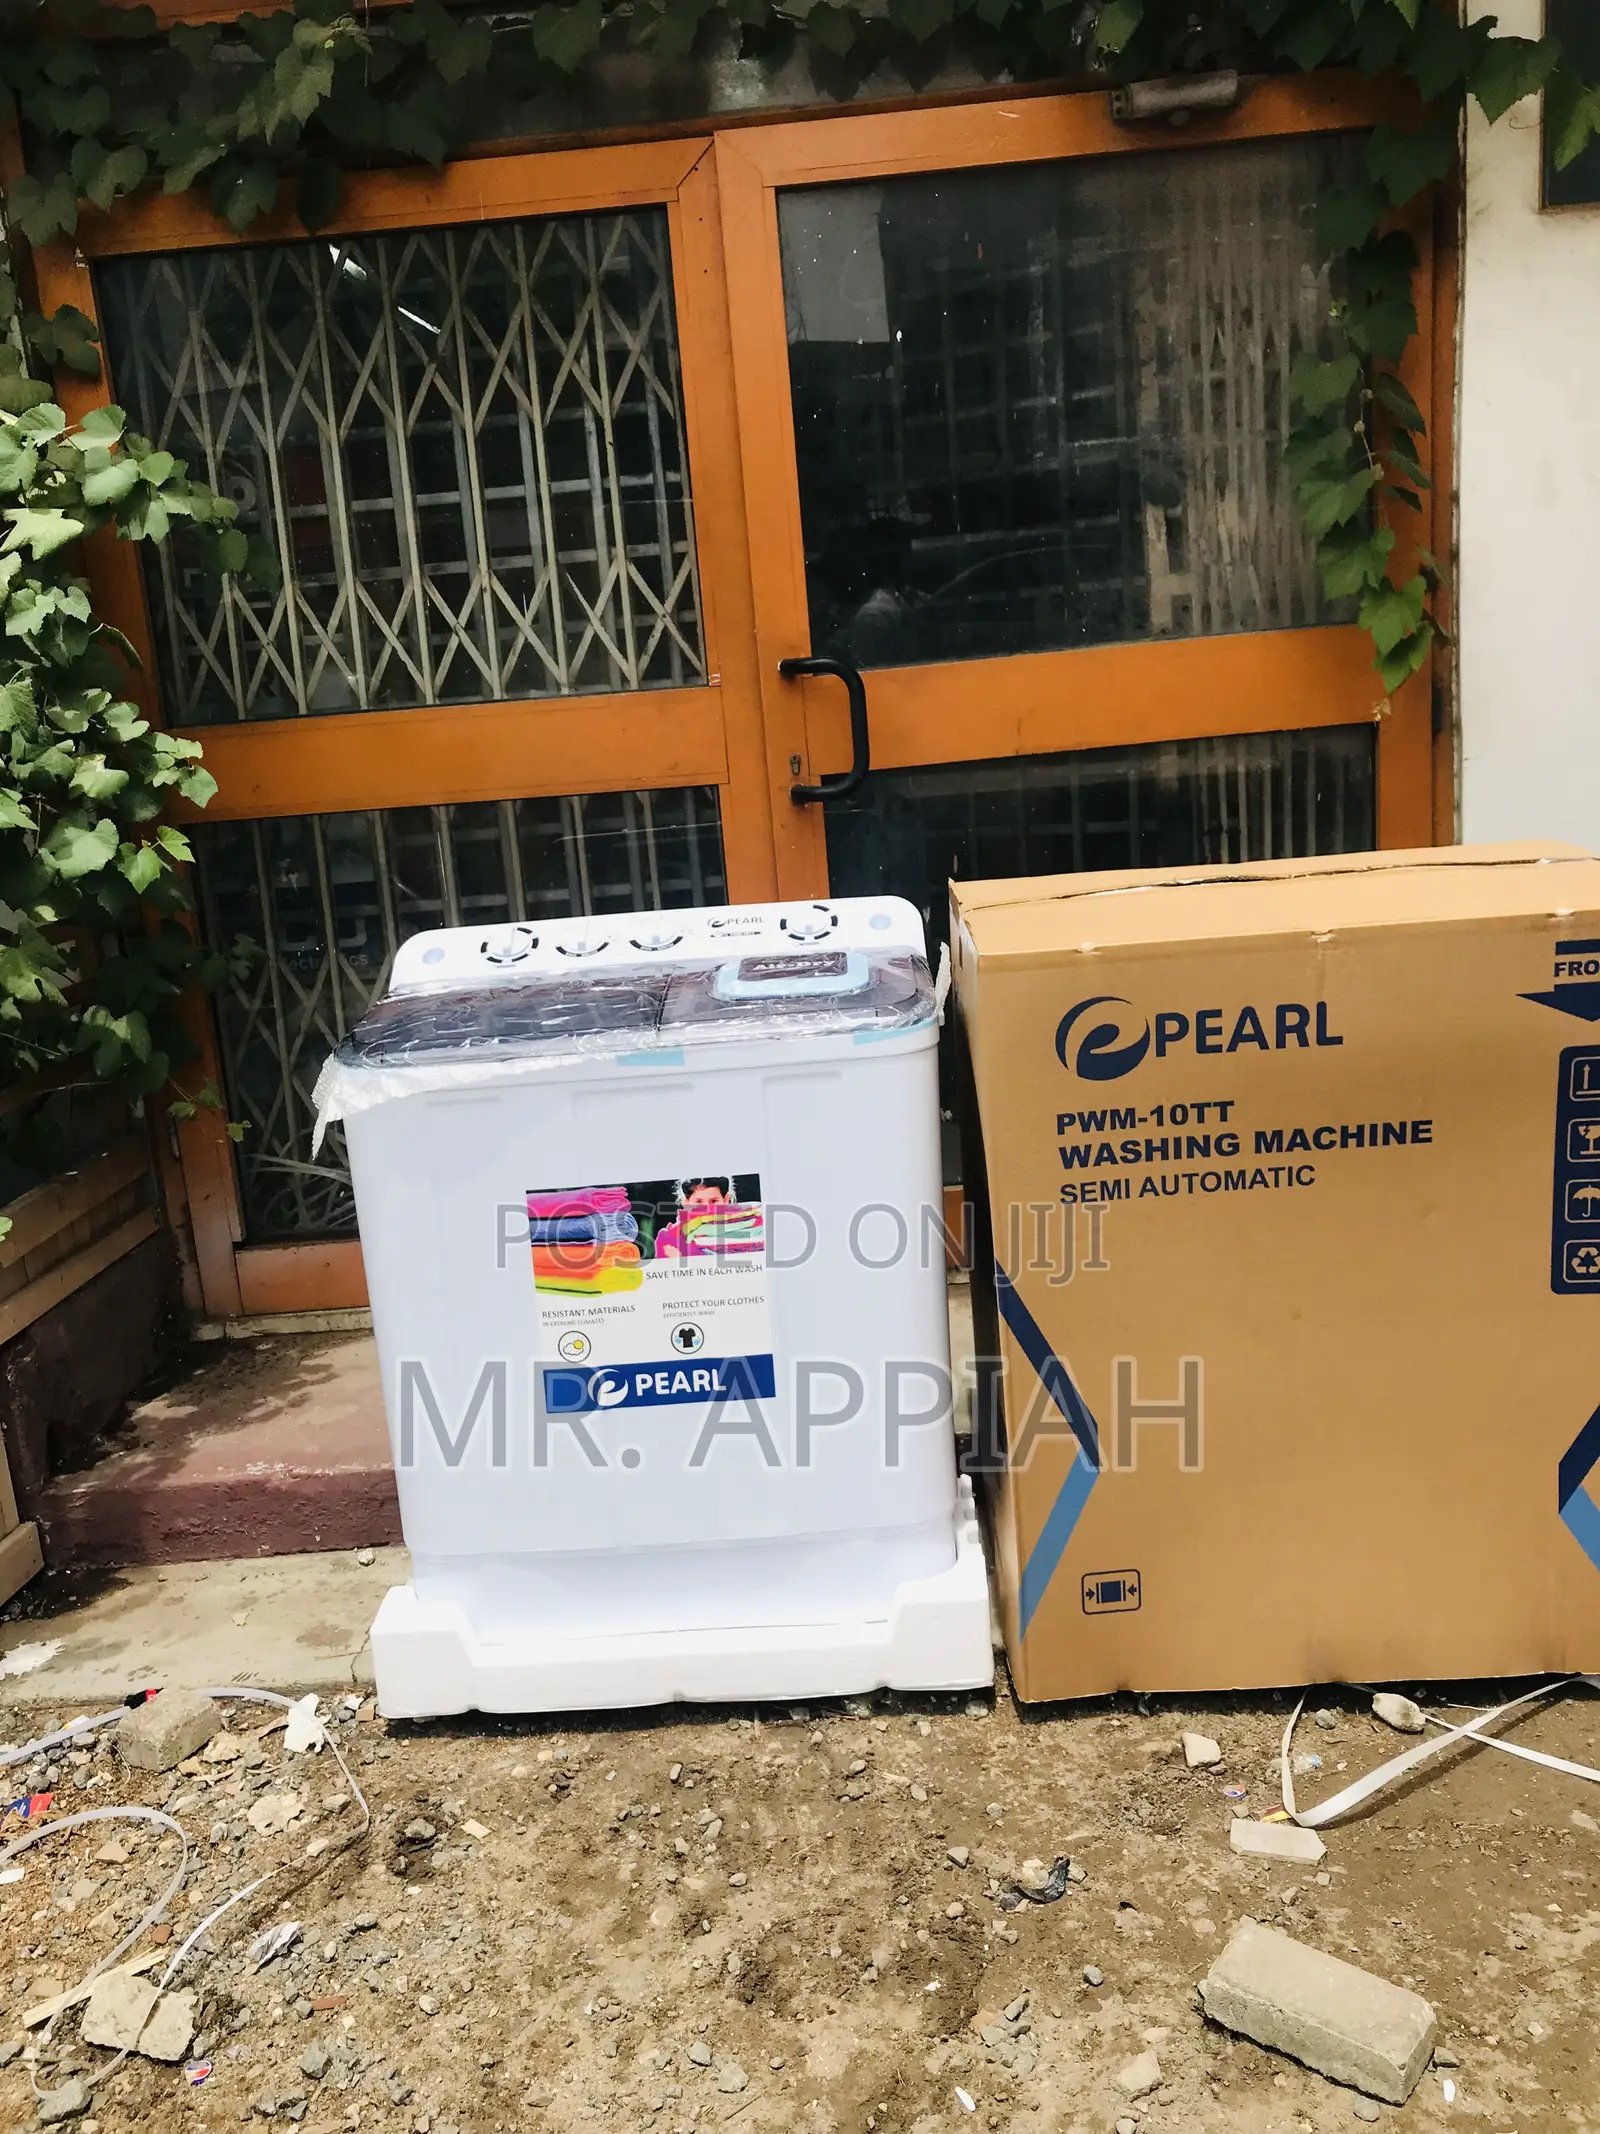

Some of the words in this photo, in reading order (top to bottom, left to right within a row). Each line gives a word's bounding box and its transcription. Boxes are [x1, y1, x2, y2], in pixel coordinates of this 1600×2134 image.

[727, 916, 765, 925] PEARL
[1554, 959, 1600, 977] FRO
[1155, 1001, 1344, 1057] PEARL
[1056, 1100, 1235, 1135] PWM-10TT
[1058, 1132, 1240, 1169] WASHING
[1254, 1119, 1433, 1154] MACHINE
[1060, 1178, 1131, 1205] SEMI
[1138, 1164, 1316, 1198] AUTOMATIC
[646, 1270, 669, 1280] SAVE
[672, 1267, 694, 1277] TIME
[697, 1266, 706, 1275] IN
[709, 1265, 732, 1276] EACH
[735, 1264, 763, 1274] WASH
[542, 1308, 586, 1319] RESISTANT
[588, 1304, 636, 1316] MATERIALS
[662, 1300, 699, 1310] PROTECT
[701, 1298, 725, 1307] YOUR
[727, 1295, 765, 1306] CLOTHES
[635, 1368, 727, 1396] PEARL
